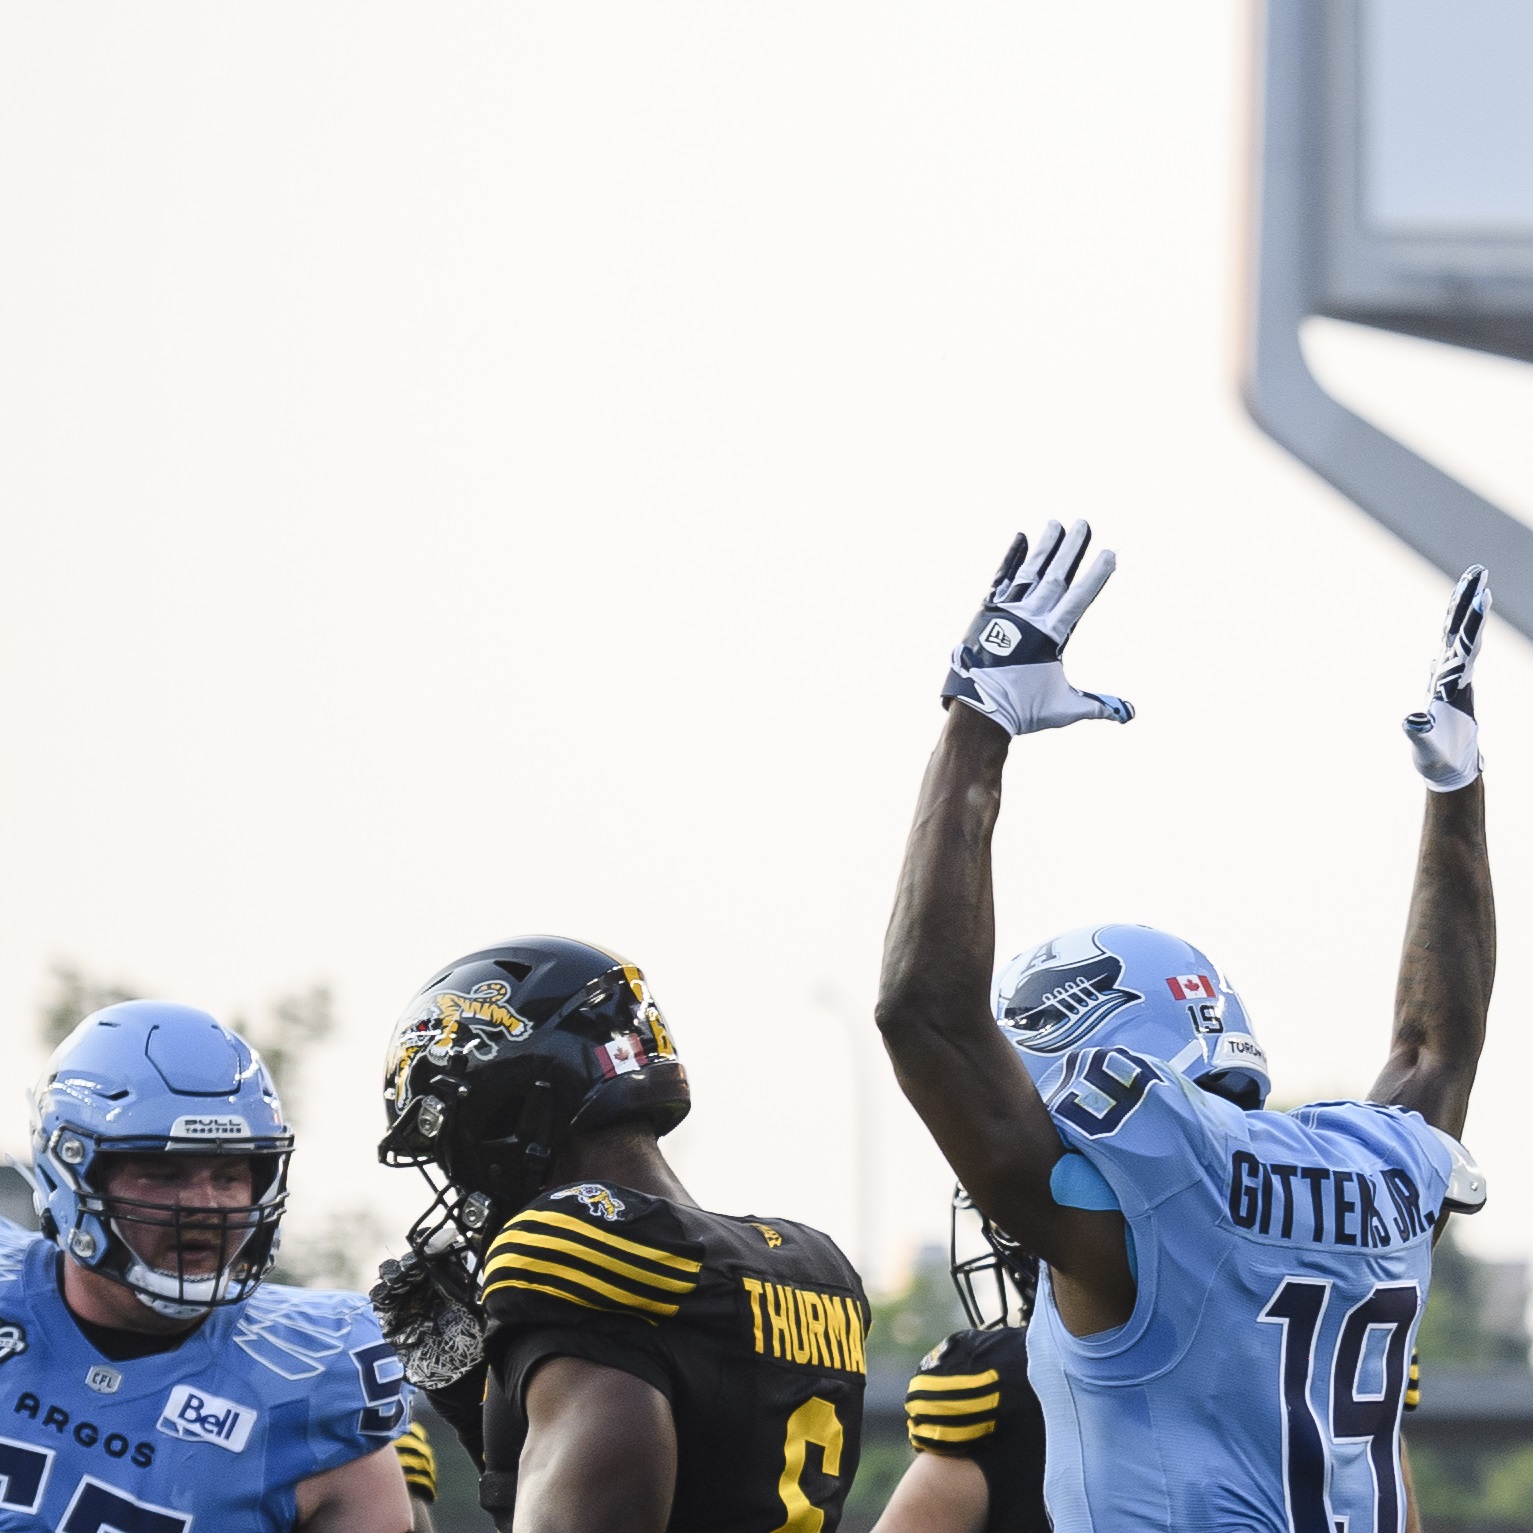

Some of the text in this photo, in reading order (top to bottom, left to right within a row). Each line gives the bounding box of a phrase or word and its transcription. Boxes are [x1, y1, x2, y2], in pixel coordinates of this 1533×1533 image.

[742, 1277, 867, 1375] THURMA
[91, 1372, 114, 1389] CFL
[13, 1392, 156, 1469] ARGOS
[177, 1393, 241, 1441] Bell
